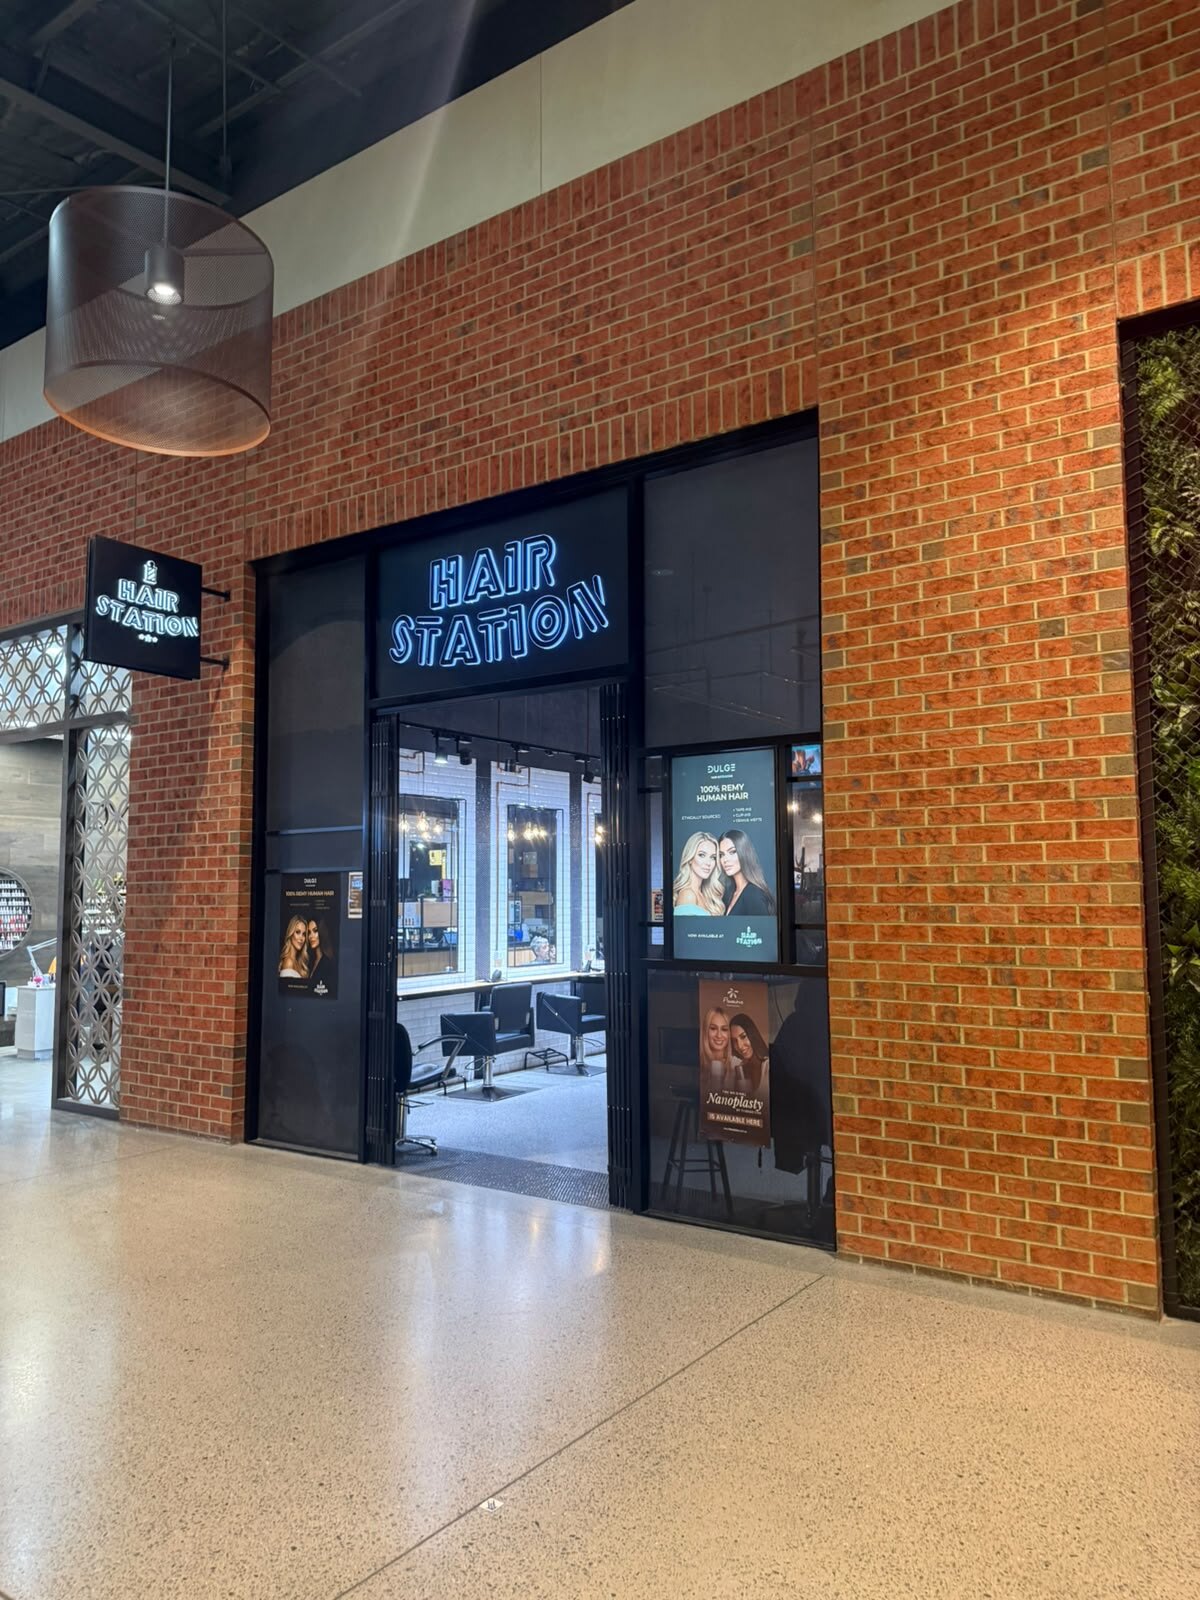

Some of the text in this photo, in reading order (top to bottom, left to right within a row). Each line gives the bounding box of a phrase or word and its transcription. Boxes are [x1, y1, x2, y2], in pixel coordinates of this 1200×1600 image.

[429, 534, 556, 610] HAIR
[118, 578, 180, 613] HAIR
[95, 594, 199, 637] STATION
[389, 574, 609, 667] STATION
[707, 764, 736, 774] DULGE
[696, 792, 749, 802] HUMAN HAIR
[721, 784, 744, 792] REMY
[706, 1092, 764, 1112] Nanoplasty
[716, 1113, 746, 1125] AVAILABLE
[746, 1117, 761, 1126] HERE
